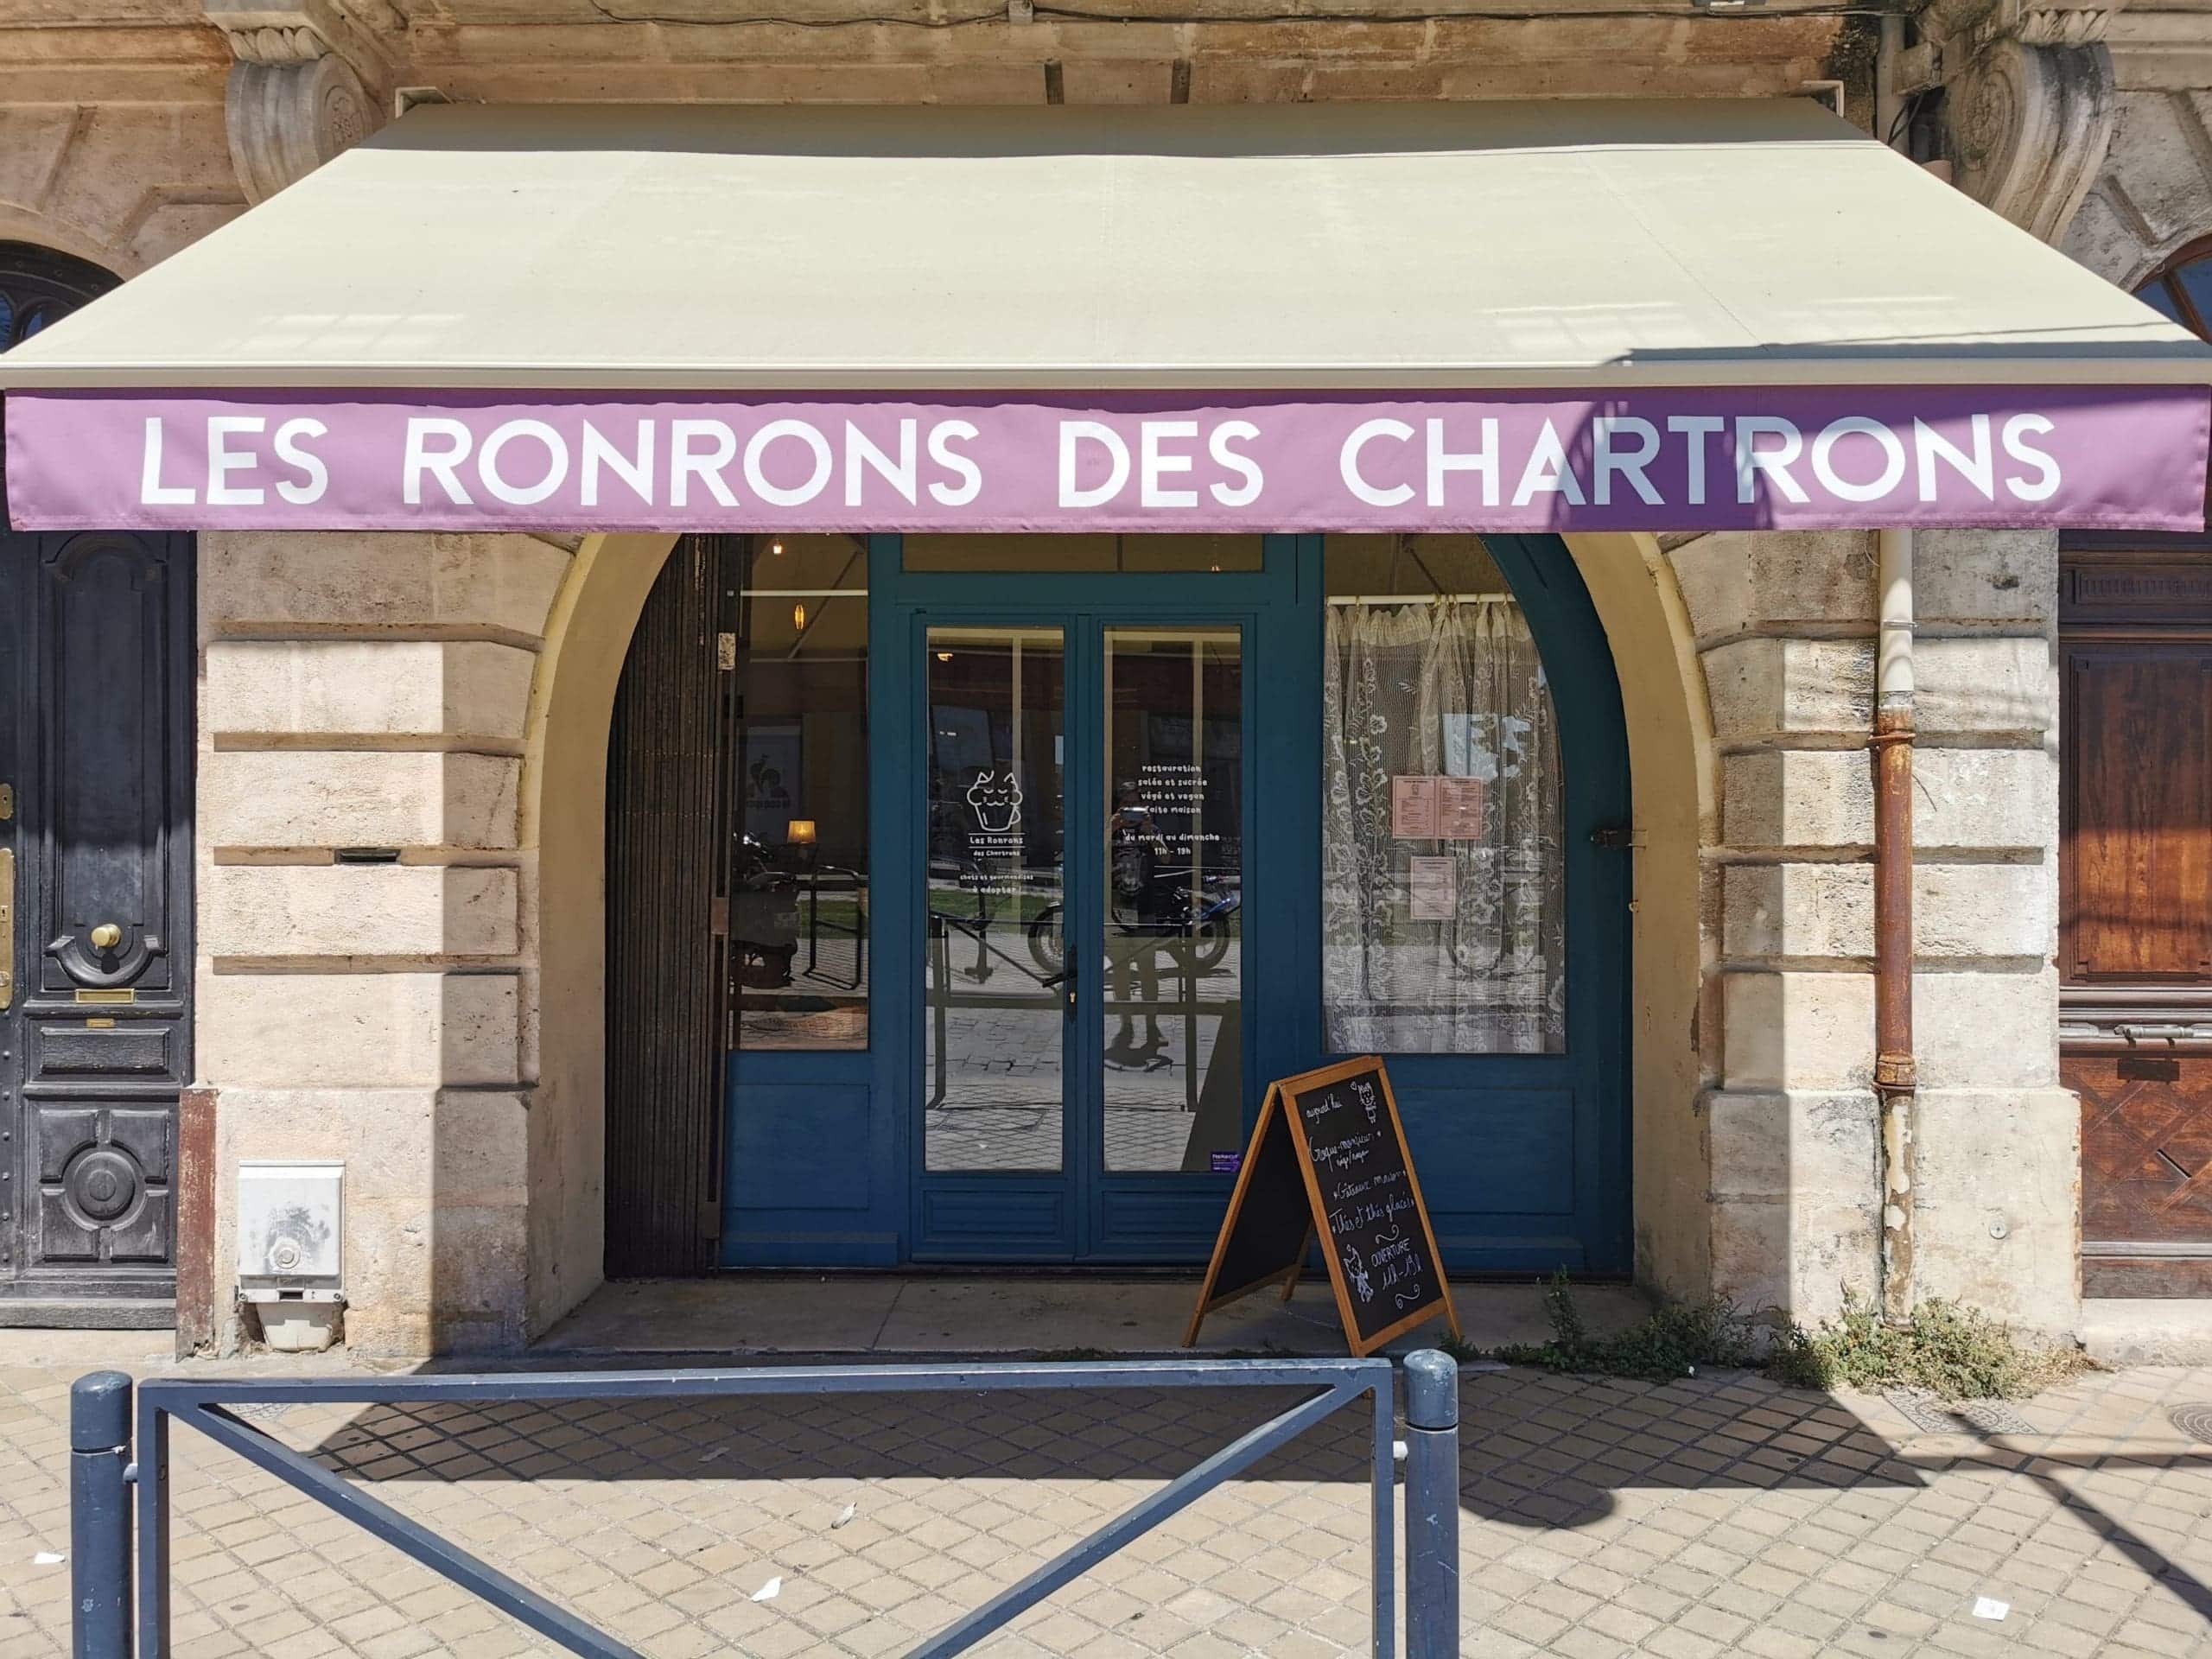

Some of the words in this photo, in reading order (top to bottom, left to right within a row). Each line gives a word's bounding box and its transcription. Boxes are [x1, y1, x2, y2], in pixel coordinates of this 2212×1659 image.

[140, 416, 329, 505] LES
[404, 416, 983, 509] RONRONS
[1058, 419, 1263, 508] DES
[1339, 413, 2062, 508] CHARTRONS
[1138, 778, 1162, 786] salée
[1178, 778, 1208, 786] sucrée
[1141, 791, 1162, 801] végé
[969, 836, 985, 844] Les
[987, 836, 1023, 844] Ronrons
[1154, 847, 1167, 855] 11h
[1177, 847, 1192, 855] 19h
[980, 885, 1017, 895] adopter
[1354, 1206, 1364, 1229] et
[1371, 1237, 1411, 1268] OUVERTURE
